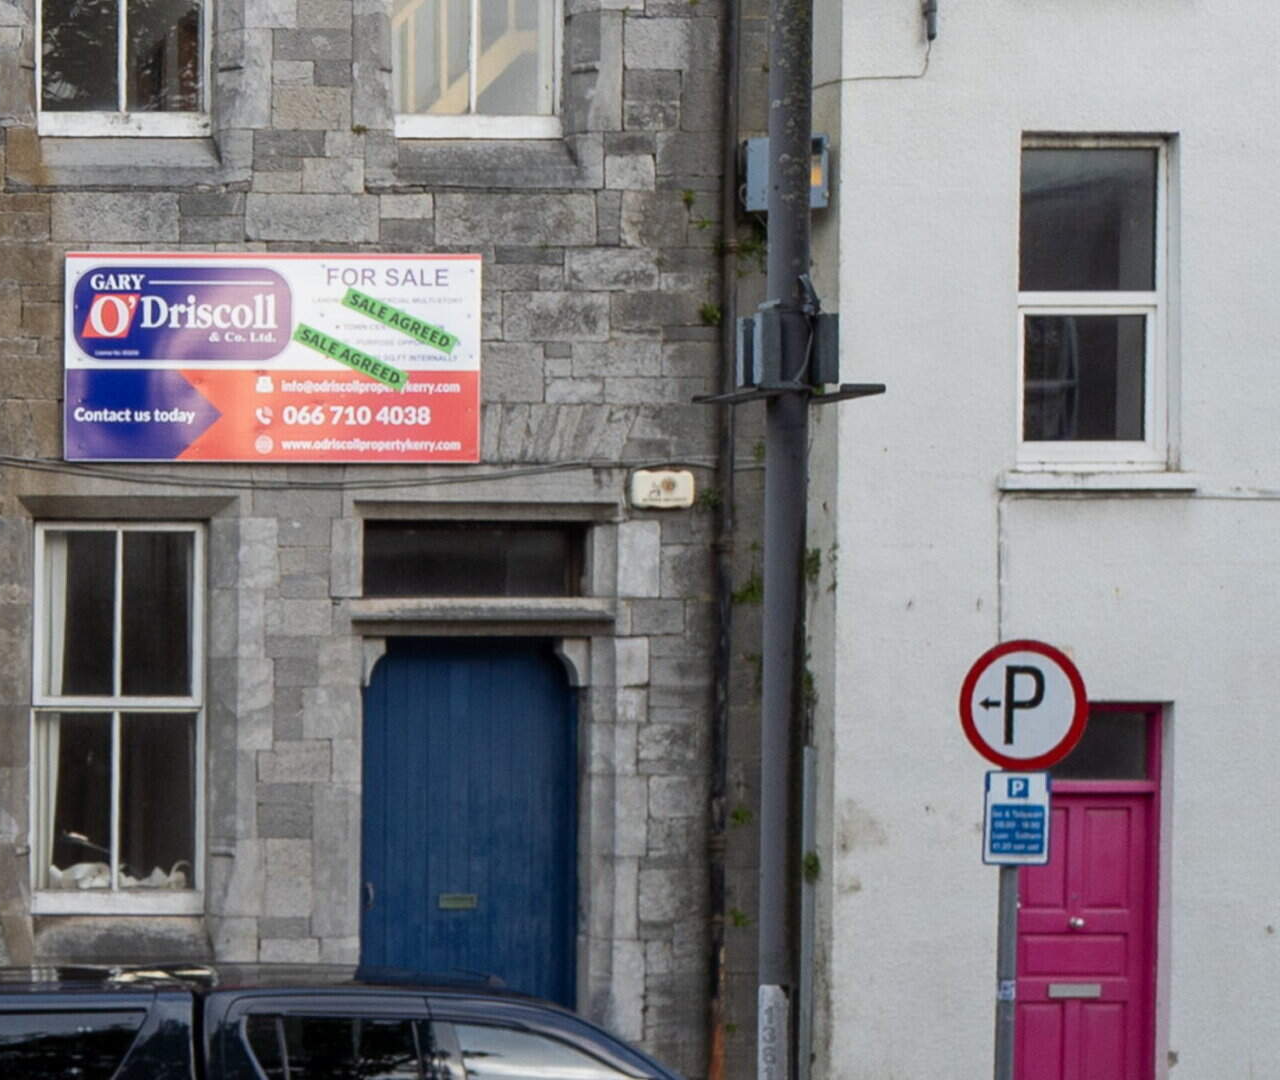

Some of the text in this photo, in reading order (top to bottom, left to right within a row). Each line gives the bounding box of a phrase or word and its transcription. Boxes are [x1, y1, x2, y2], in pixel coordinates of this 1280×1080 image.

[90, 274, 145, 290] GARY
[326, 268, 449, 287] FOR SALE
[90, 294, 278, 337] O'Driscoll
[350, 294, 450, 347] SALE AGREED
[209, 331, 276, 343] & Co. Ltd.
[301, 329, 401, 385] SALE AGREED
[74, 407, 195, 424] Contact us today
[282, 406, 431, 425] 066 710 4038
[281, 438, 461, 452] www.odriscollpropertykerry.com
[1004, 666, 1046, 745] P
[1012, 780, 1024, 796] P
